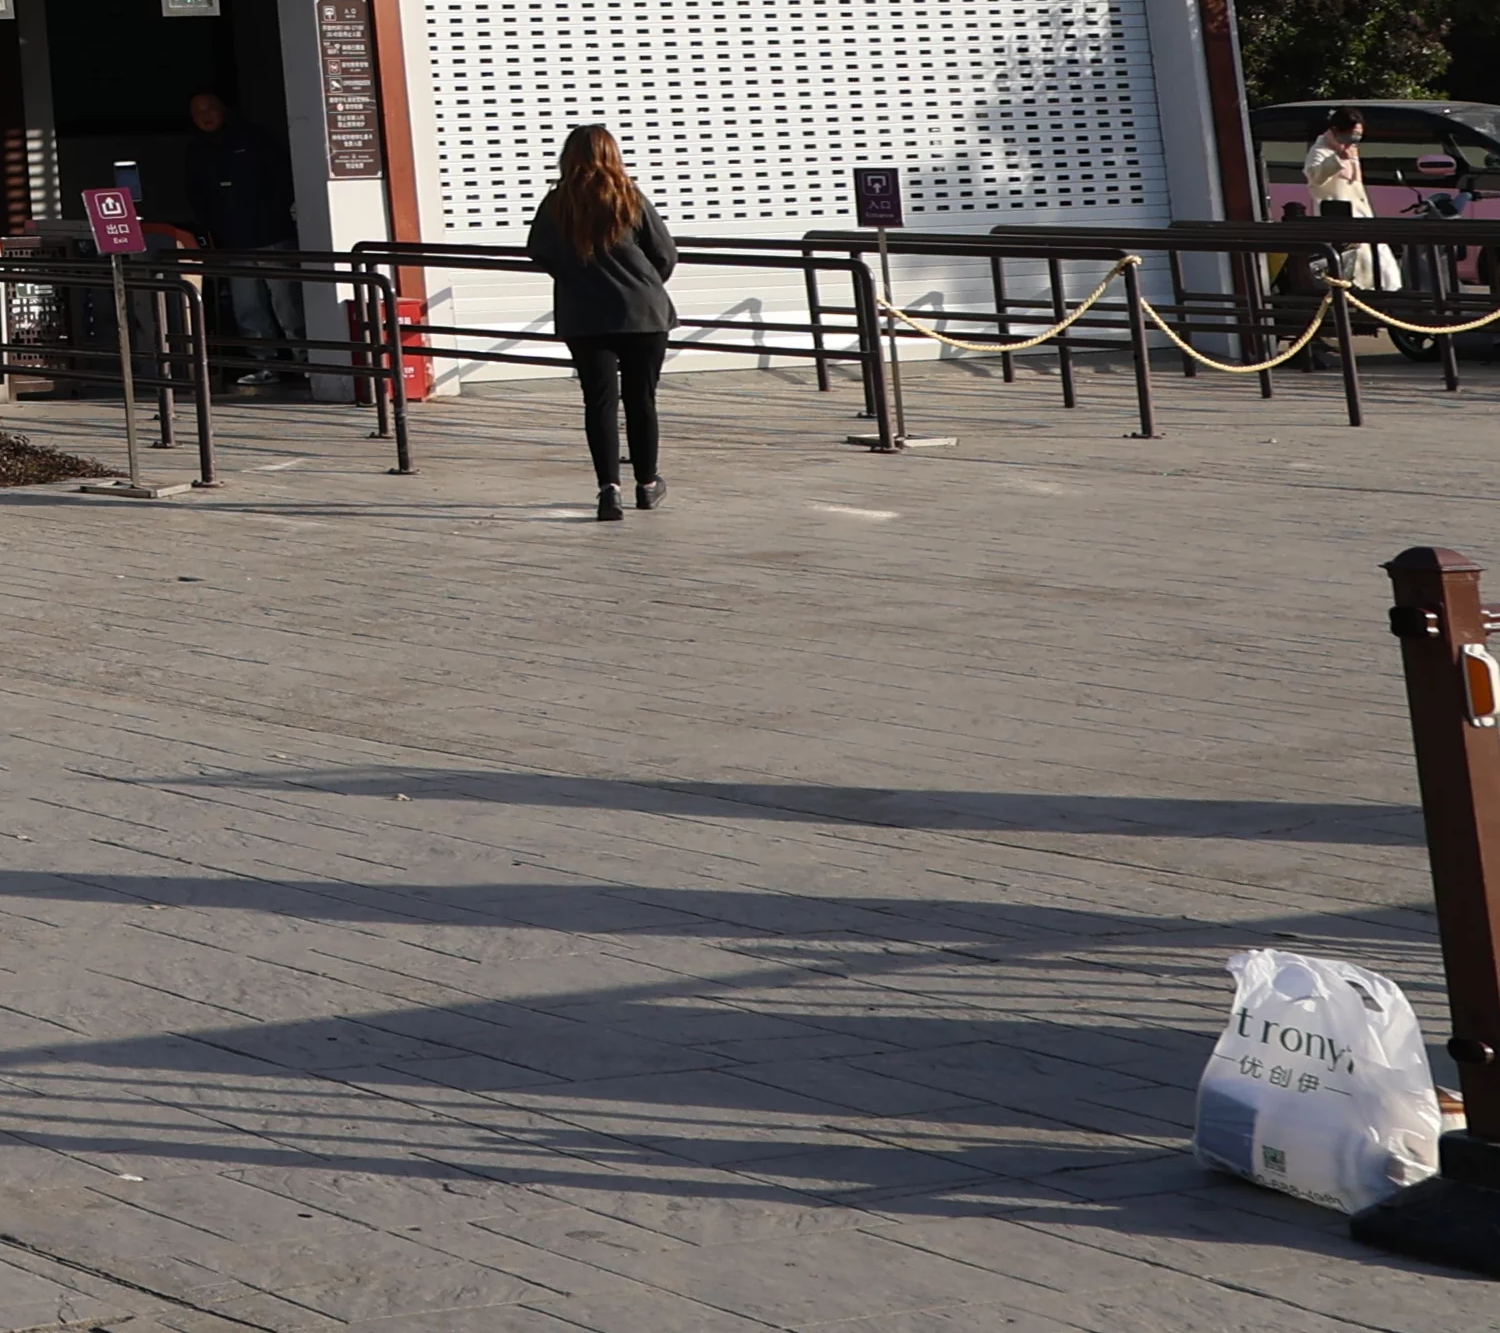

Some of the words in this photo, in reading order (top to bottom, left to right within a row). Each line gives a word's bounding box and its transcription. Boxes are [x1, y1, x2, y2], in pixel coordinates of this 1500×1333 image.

[868, 200, 891, 210] 入口
[106, 223, 130, 235] 出口
[1239, 1055, 1320, 1094] 优创伊
